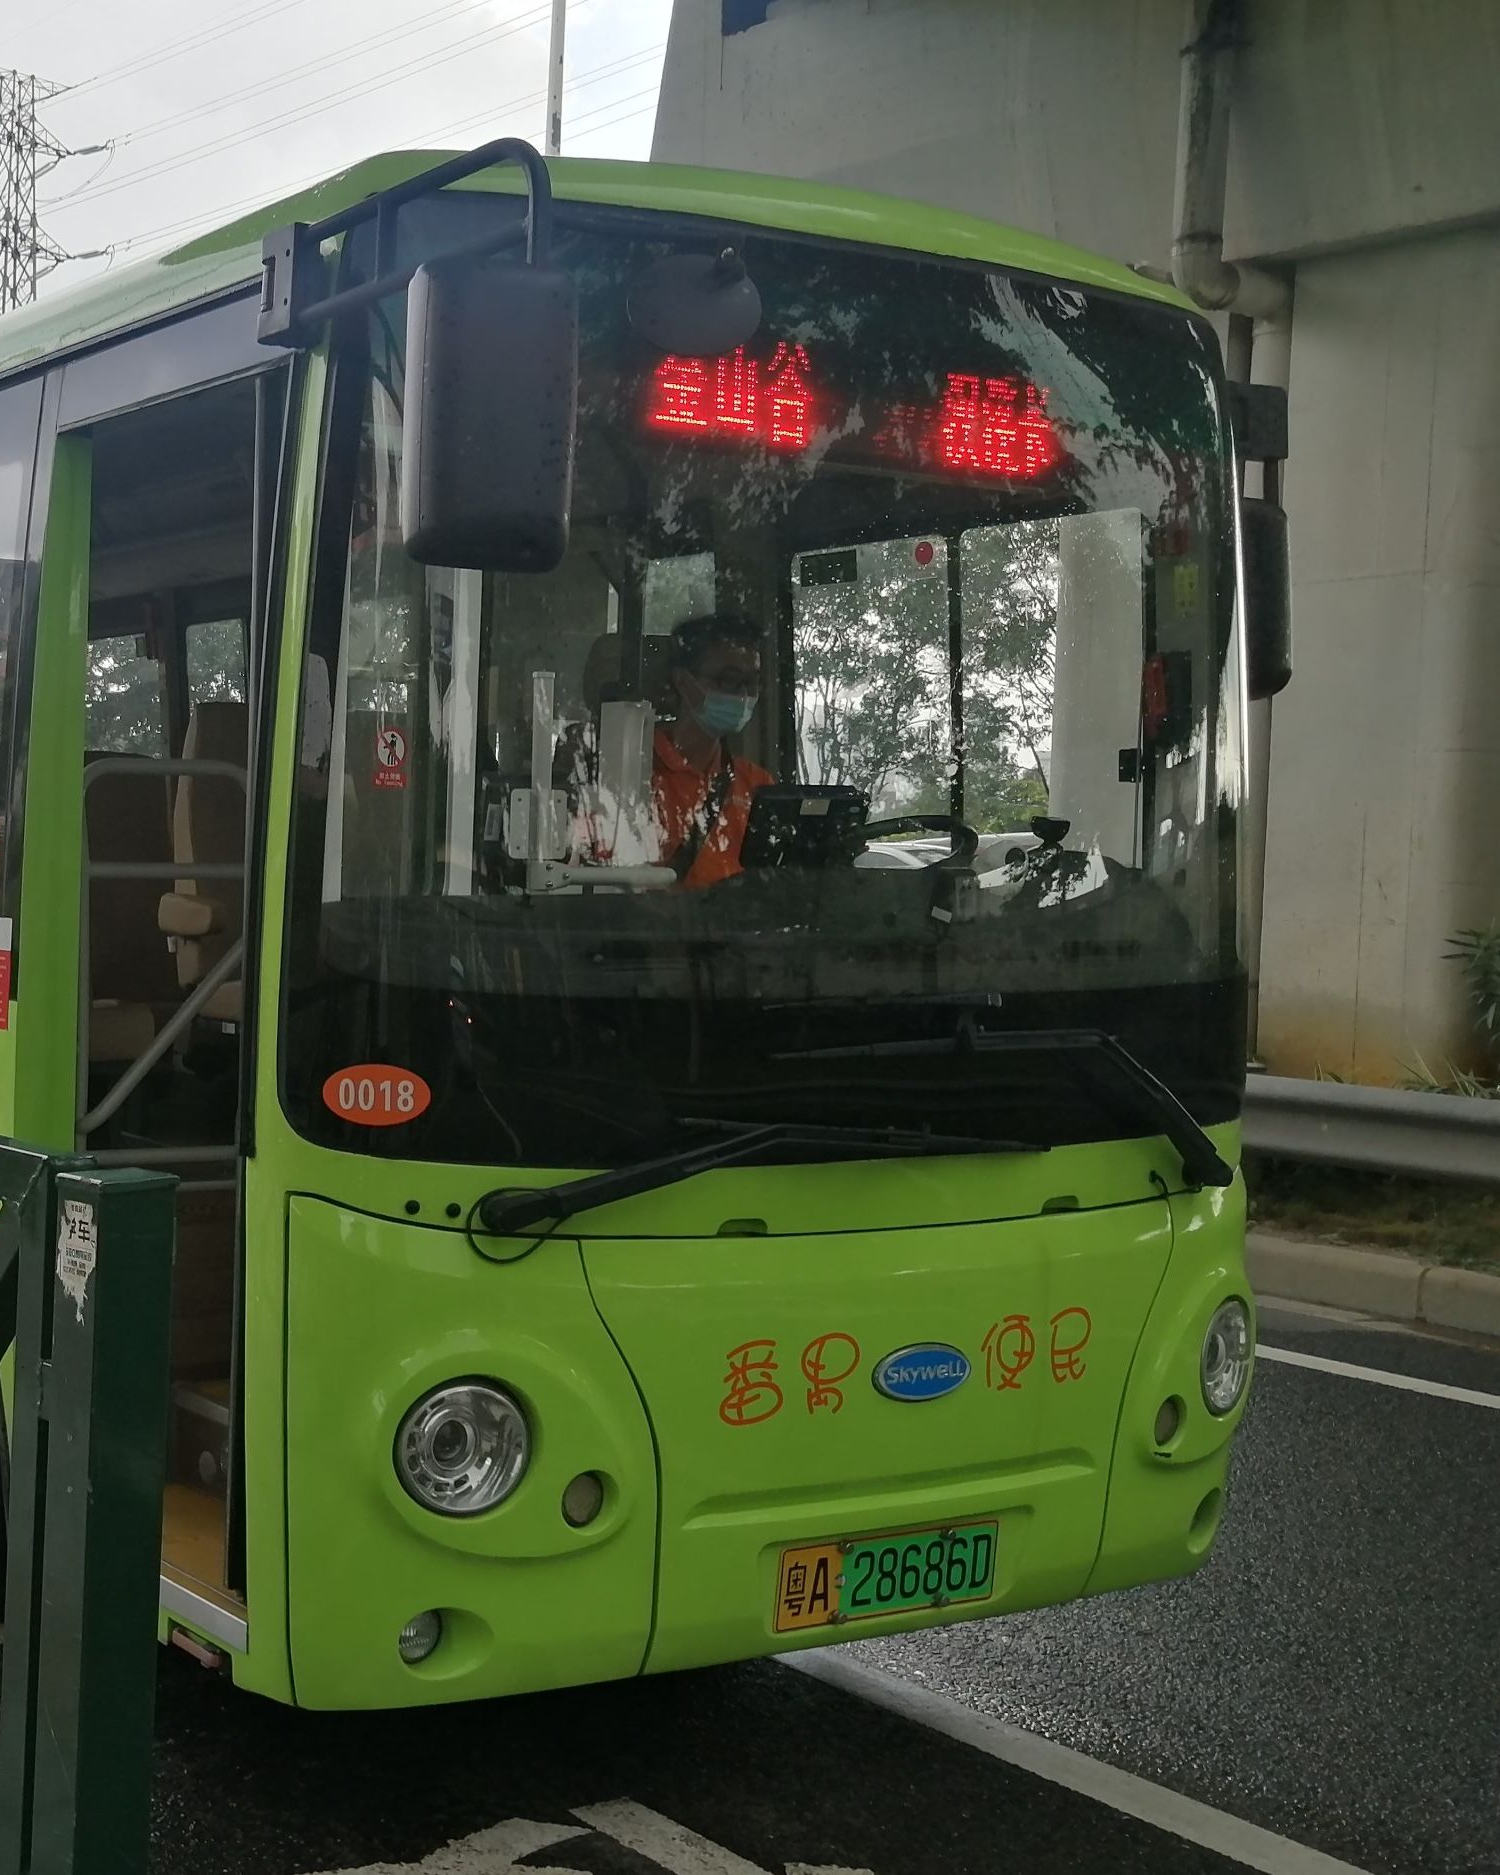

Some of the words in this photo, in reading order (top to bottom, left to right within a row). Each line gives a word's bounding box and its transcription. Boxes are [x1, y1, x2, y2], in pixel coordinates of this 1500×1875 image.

[338, 1078, 415, 1112] 0018
[718, 1331, 861, 1427] 番禺
[886, 1359, 964, 1385] Skywell
[980, 1306, 1093, 1391] 便民
[783, 1556, 830, 1618] 粤A
[850, 1533, 992, 1607] 28686D
